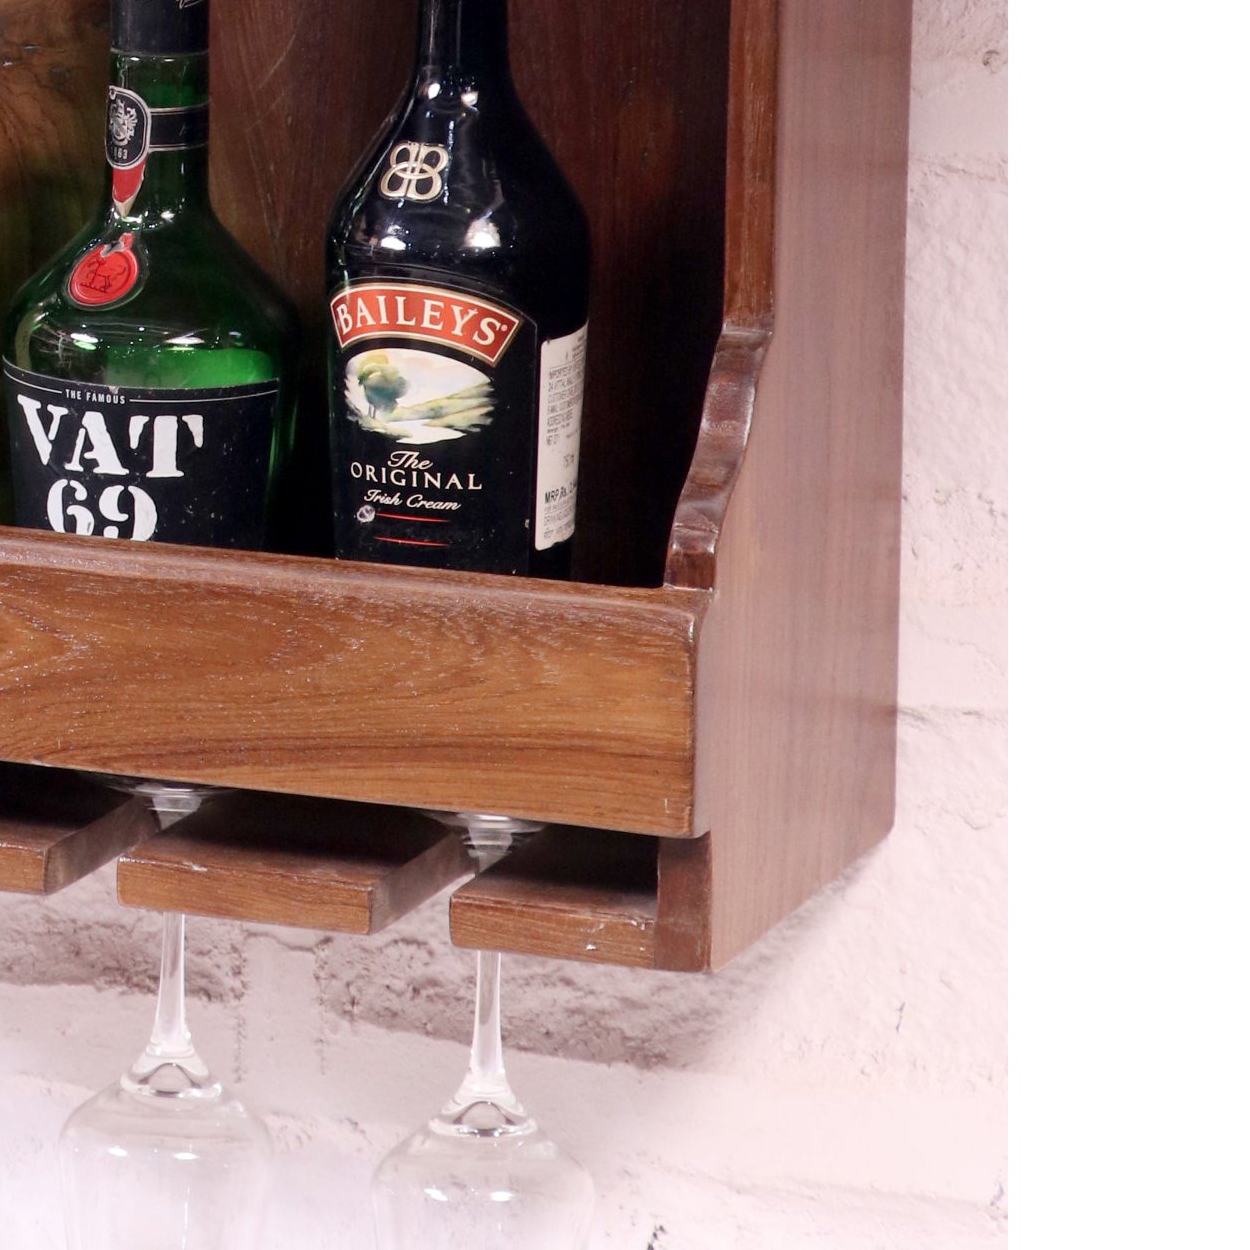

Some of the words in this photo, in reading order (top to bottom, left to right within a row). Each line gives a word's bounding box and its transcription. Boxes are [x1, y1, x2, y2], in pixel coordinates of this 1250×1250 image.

[336, 294, 502, 347] BAILEYS
[65, 388, 82, 401] THE
[86, 391, 126, 406] FAMOUS
[17, 394, 204, 479] VAT
[387, 450, 434, 470] The
[350, 461, 483, 490] ORIGINAL
[47, 478, 158, 542] 69
[363, 489, 404, 507] Irish
[406, 494, 462, 511] Cream
